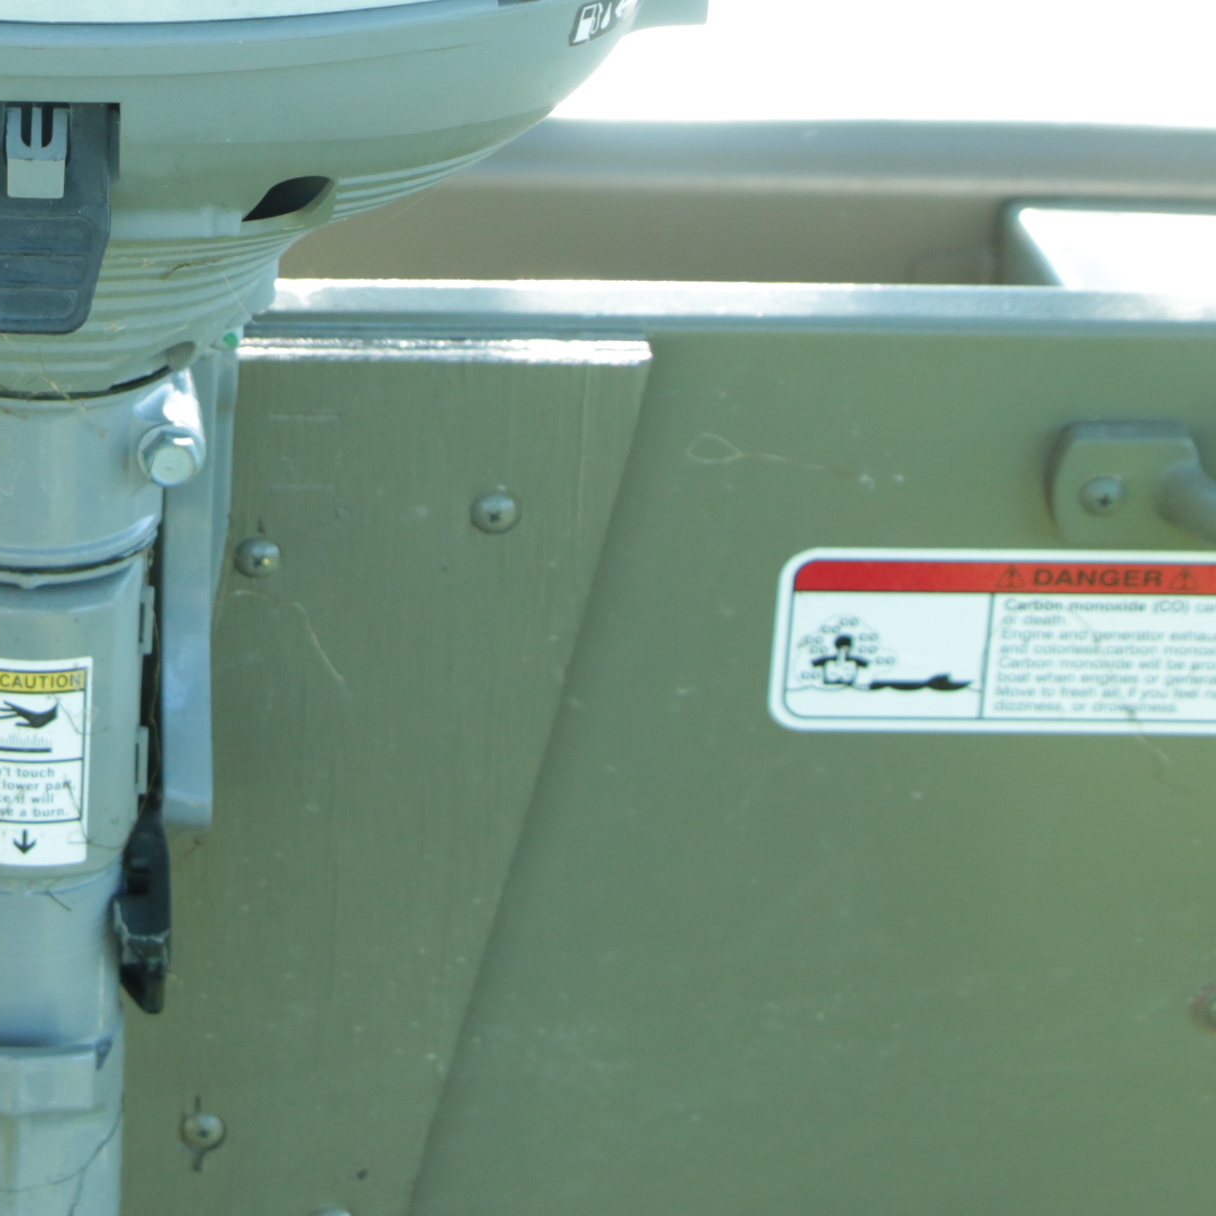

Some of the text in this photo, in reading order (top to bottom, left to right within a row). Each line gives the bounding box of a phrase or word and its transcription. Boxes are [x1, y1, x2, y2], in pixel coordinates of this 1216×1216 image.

[1033, 568, 1163, 588] DANGER
[1005, 598, 1064, 611] Carbon
[1069, 600, 1147, 612] monoxide
[1154, 599, 1190, 614] (CO)
[1060, 630, 1088, 641] and
[0, 673, 82, 689] CAUTION
[17, 767, 55, 778] touch
[3, 779, 40, 791] lower
[31, 793, 54, 803] will
[19, 808, 27, 817] a
